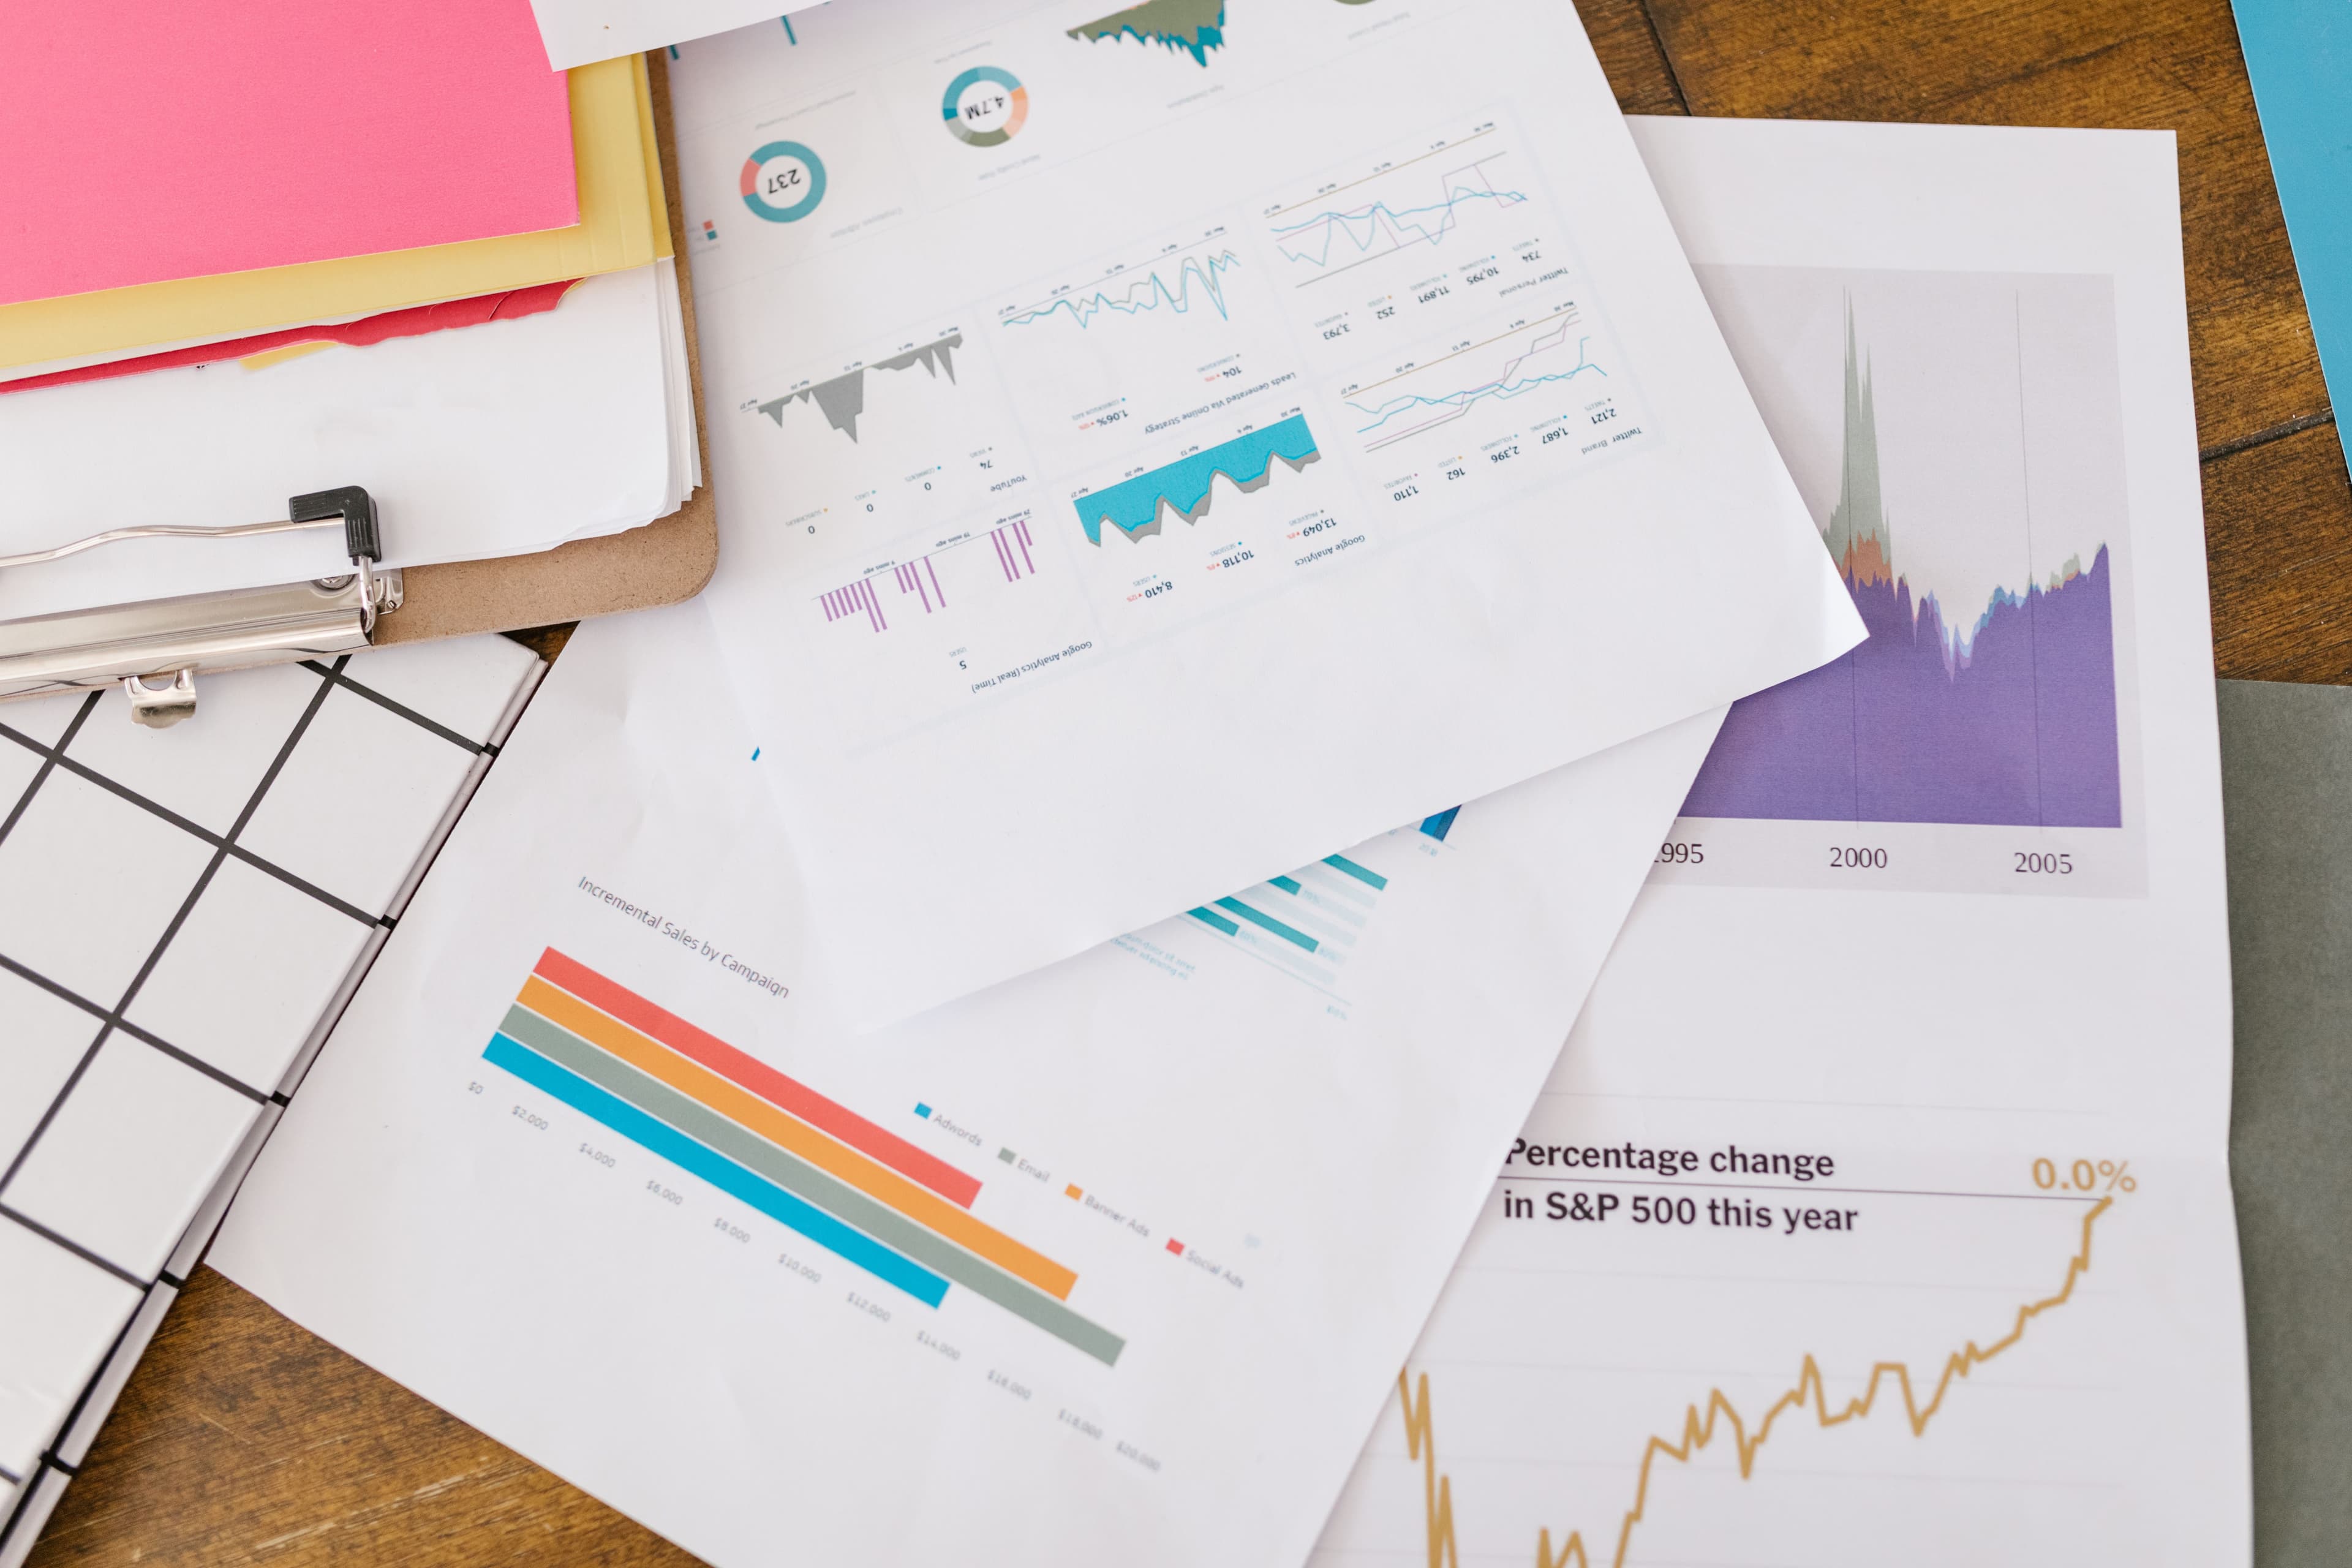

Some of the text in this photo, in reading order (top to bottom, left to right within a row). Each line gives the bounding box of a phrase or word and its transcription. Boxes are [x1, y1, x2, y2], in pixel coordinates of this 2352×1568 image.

[964, 96, 1004, 120] 4.7M
[767, 168, 801, 195] 237
[1521, 250, 1542, 263] 734
[1466, 266, 1500, 285] 10,795
[1499, 267, 1569, 298] Twitter Personal
[1417, 286, 1450, 304] 11,891
[1376, 306, 1395, 320] 252
[1322, 323, 1351, 341] 3,793
[1222, 366, 1242, 378] 104
[1144, 372, 1297, 435] Leads Generated Via Online Strategy
[1096, 409, 1129, 427] 1.06%
[1591, 408, 1617, 425] 2,121
[1542, 427, 1569, 445] 1,687
[1581, 427, 1642, 455] Twitter Brand
[1490, 445, 1520, 464] 2,396
[979, 459, 993, 470] 74
[1446, 467, 1466, 481] 162
[924, 481, 932, 491] 0
[990, 475, 1028, 492] YouTube
[1393, 485, 1419, 502] 1,110
[865, 503, 874, 513] 0
[807, 525, 816, 535] 0
[1302, 518, 1337, 537] 13,049
[1222, 549, 1255, 568] 10,118
[1294, 535, 1366, 567] Google Analytics
[1145, 581, 1173, 598] 8,410
[959, 660, 967, 670] 5
[971, 641, 1093, 694] Google Analytics (Real Time)
[1653, 840, 1704, 864] 995
[1830, 846, 1888, 869] 2000
[2014, 852, 2073, 875] 2005
[578, 876, 663, 929] Incremental
[661, 922, 700, 950] Sales
[700, 940, 720, 962] by
[467, 1081, 484, 1095] $0
[932, 1114, 983, 1147] Adwords
[1503, 1137, 1834, 1182] Percentage change
[1016, 1158, 1051, 1183] Email
[2031, 1157, 2138, 1196] 0.0%
[1084, 1194, 1150, 1238] Banner Ads
[1504, 1189, 1859, 1235] in S&P 500 this year
[1185, 1250, 1244, 1289] Social Ads
